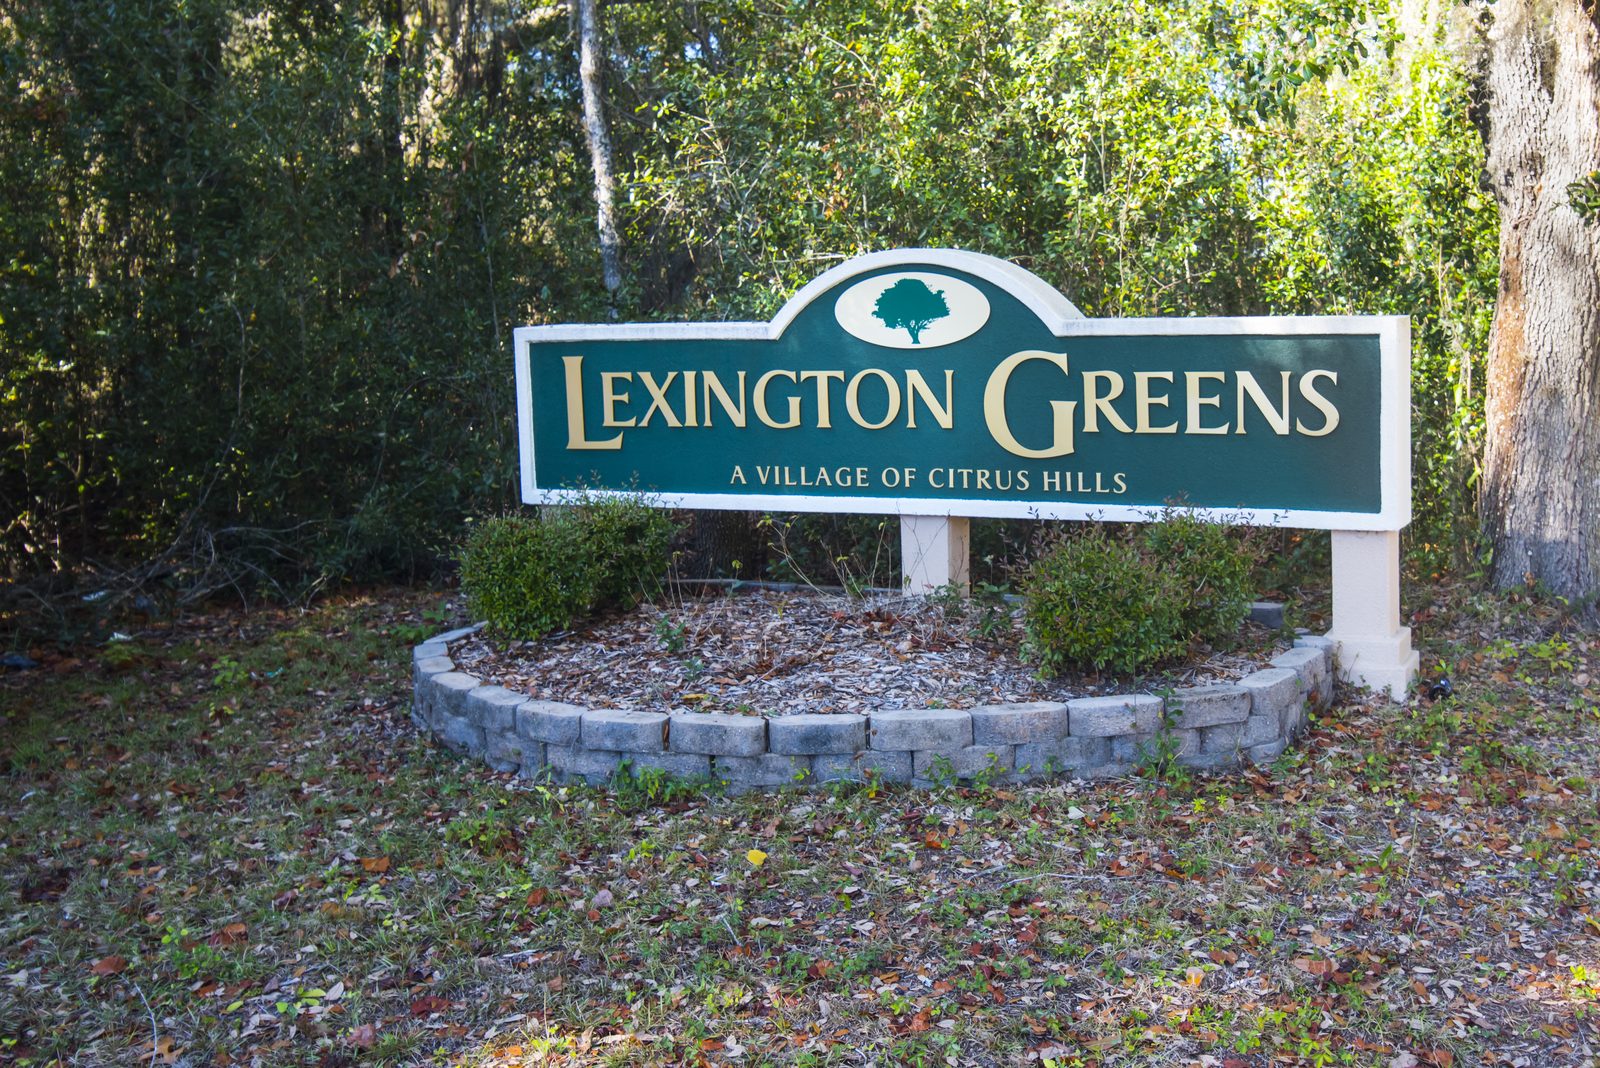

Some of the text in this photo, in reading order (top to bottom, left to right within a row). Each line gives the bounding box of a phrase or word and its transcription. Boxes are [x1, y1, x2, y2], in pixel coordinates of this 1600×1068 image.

[562, 349, 1340, 459] LEXINGTON GREENS
[730, 465, 1127, 495] A VILLAGE OF CITRUS HILLS
